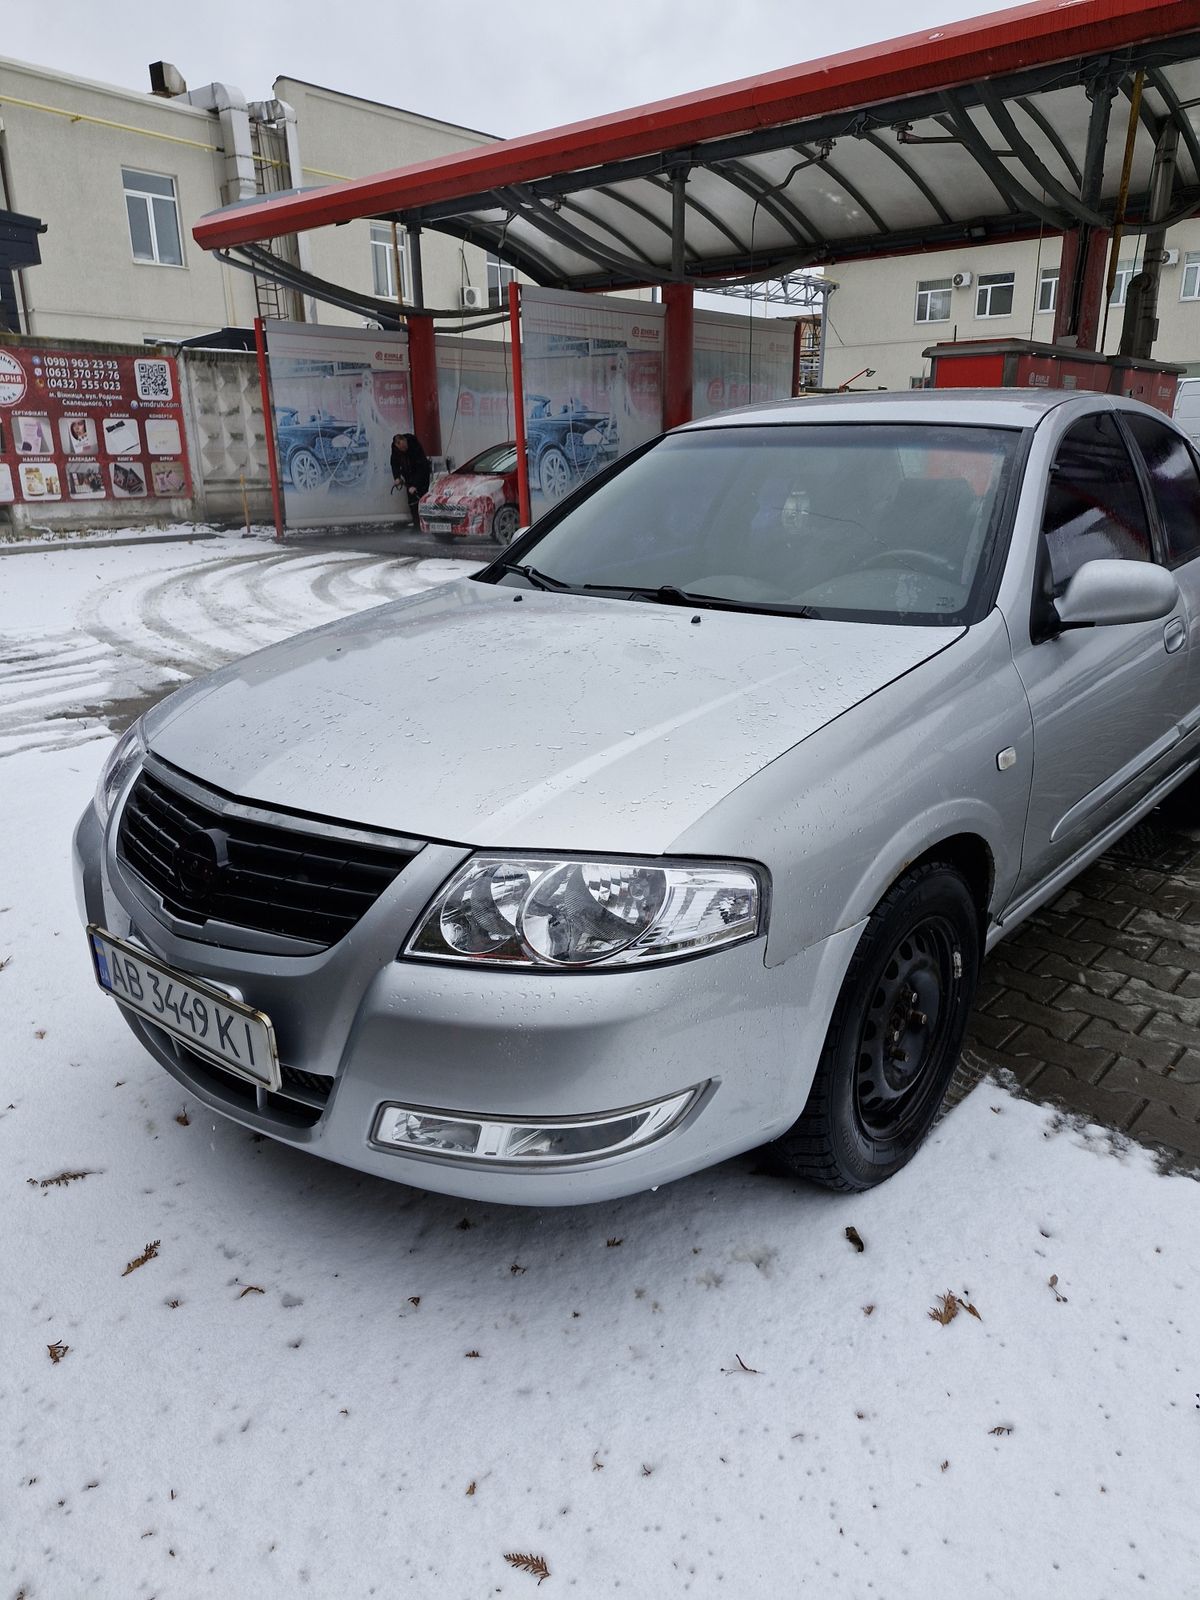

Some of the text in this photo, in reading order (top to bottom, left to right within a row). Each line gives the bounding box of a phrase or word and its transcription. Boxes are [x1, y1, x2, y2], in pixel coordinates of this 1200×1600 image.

[43, 356, 69, 367] (098)
[45, 367, 71, 379] (063)
[47, 378, 78, 390] (0432)
[111, 951, 144, 1001] AB
[147, 971, 209, 1037] 3449
